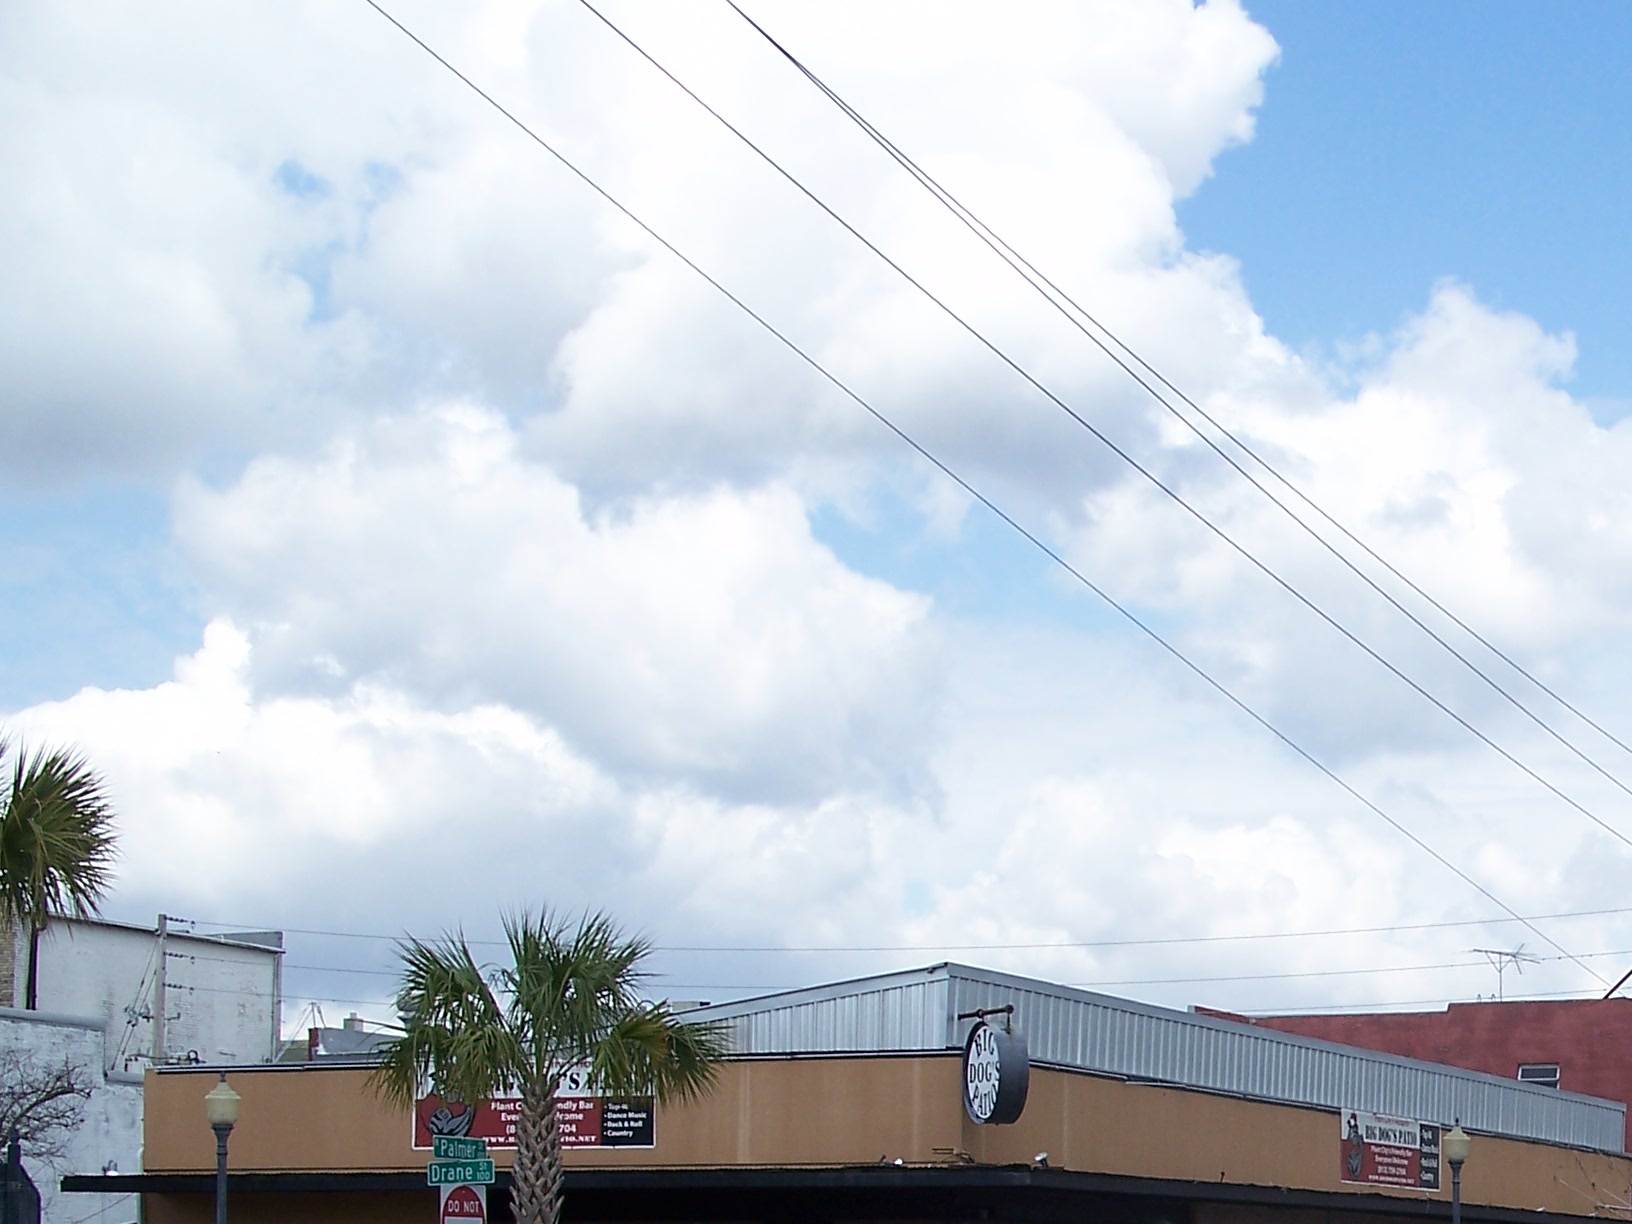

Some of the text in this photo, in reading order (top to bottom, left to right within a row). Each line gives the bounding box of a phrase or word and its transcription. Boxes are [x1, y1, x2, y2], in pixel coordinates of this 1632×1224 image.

[975, 1028, 995, 1057] BIG
[969, 1060, 1002, 1084] DOG'S
[490, 1101, 513, 1111] Plant
[972, 1083, 997, 1116] PATIO
[607, 1130, 634, 1139] Country
[441, 1139, 476, 1159] Palmer
[431, 1165, 474, 1182] Drane
[479, 1162, 487, 1170] St
[477, 1172, 491, 1181] 100
[447, 1200, 479, 1213] DO NOT
